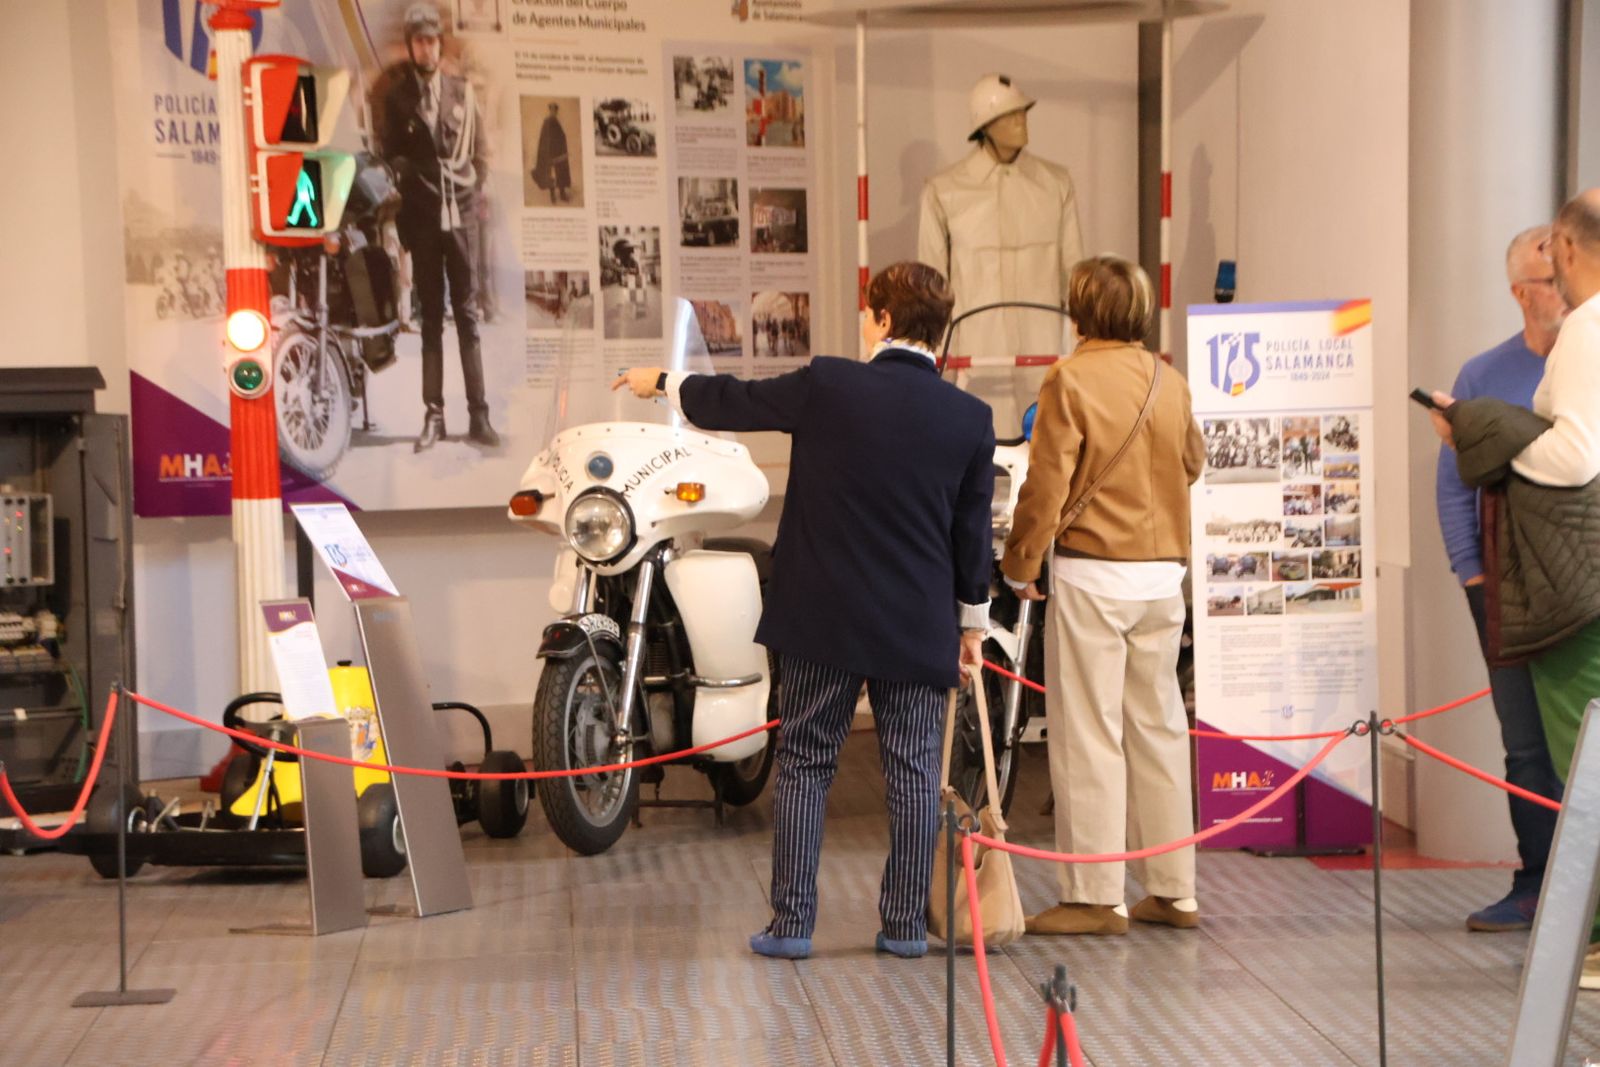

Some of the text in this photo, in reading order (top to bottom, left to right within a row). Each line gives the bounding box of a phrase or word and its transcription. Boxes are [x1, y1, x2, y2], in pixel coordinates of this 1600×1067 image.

[586, 0, 628, 12] Cuerpo
[512, 11, 646, 32] de Agentes Municipales
[154, 92, 217, 115] POLICÍA
[154, 119, 220, 145] SALAM
[1266, 337, 1353, 352] POLICÍA LOCAL
[1206, 332, 1260, 395] 175
[1266, 353, 1355, 371] SALAMANCA
[160, 453, 222, 477] MHA
[622, 446, 692, 498] MUNICIPAL
[1212, 771, 1263, 789] MHA
